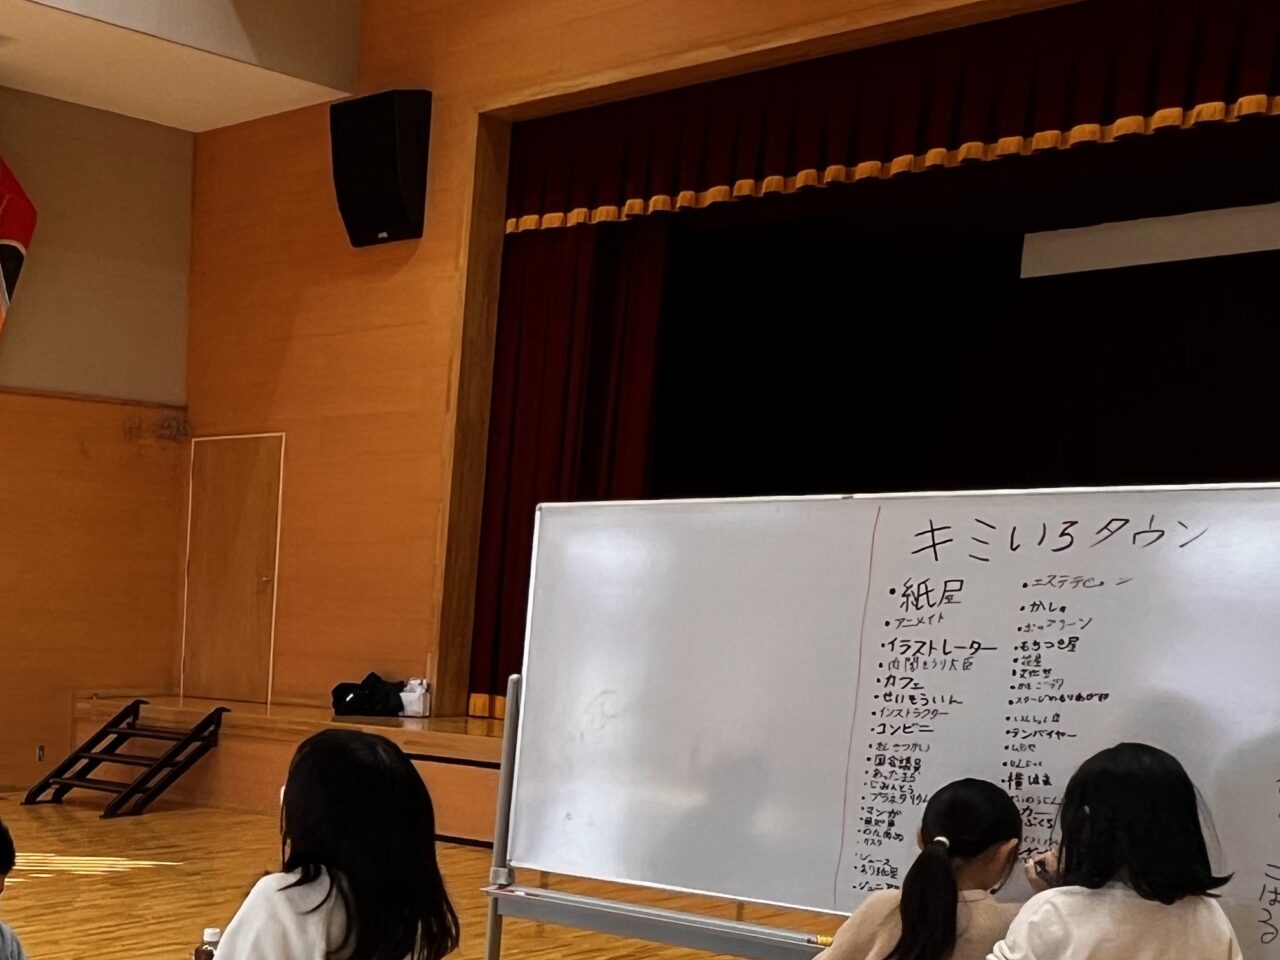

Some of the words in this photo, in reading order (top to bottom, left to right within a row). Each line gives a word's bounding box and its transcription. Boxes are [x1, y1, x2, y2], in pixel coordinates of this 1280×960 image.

[911, 514, 1209, 561] キミいろタウン
[900, 577, 964, 612] 紙屋
[895, 612, 944, 629] アニメイト
[888, 637, 998, 657] イラストレーター
[884, 674, 925, 689] カフェ
[879, 707, 950, 719] インストラクター
[876, 722, 935, 735] コンビニ
